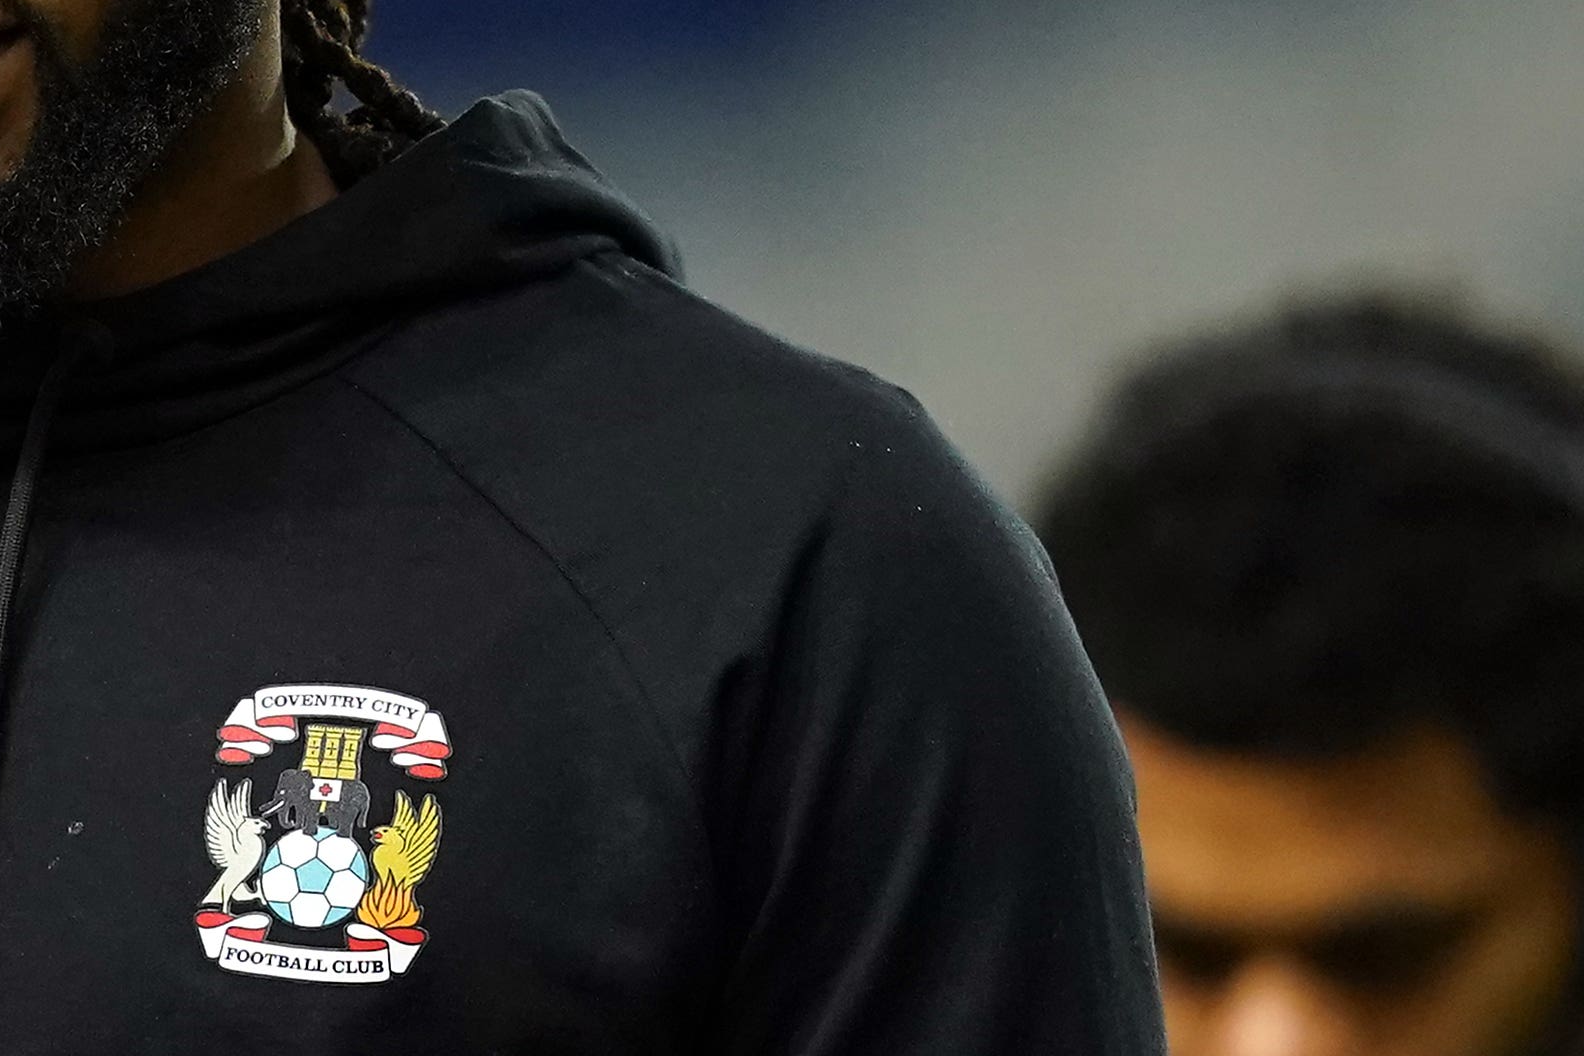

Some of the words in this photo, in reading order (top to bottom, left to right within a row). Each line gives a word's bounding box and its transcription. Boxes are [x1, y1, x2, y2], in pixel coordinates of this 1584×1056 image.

[261, 694, 367, 710] COVENTRY
[371, 698, 419, 721] CITY
[224, 947, 328, 973] FOOTBALL
[332, 959, 384, 974] CLUB
